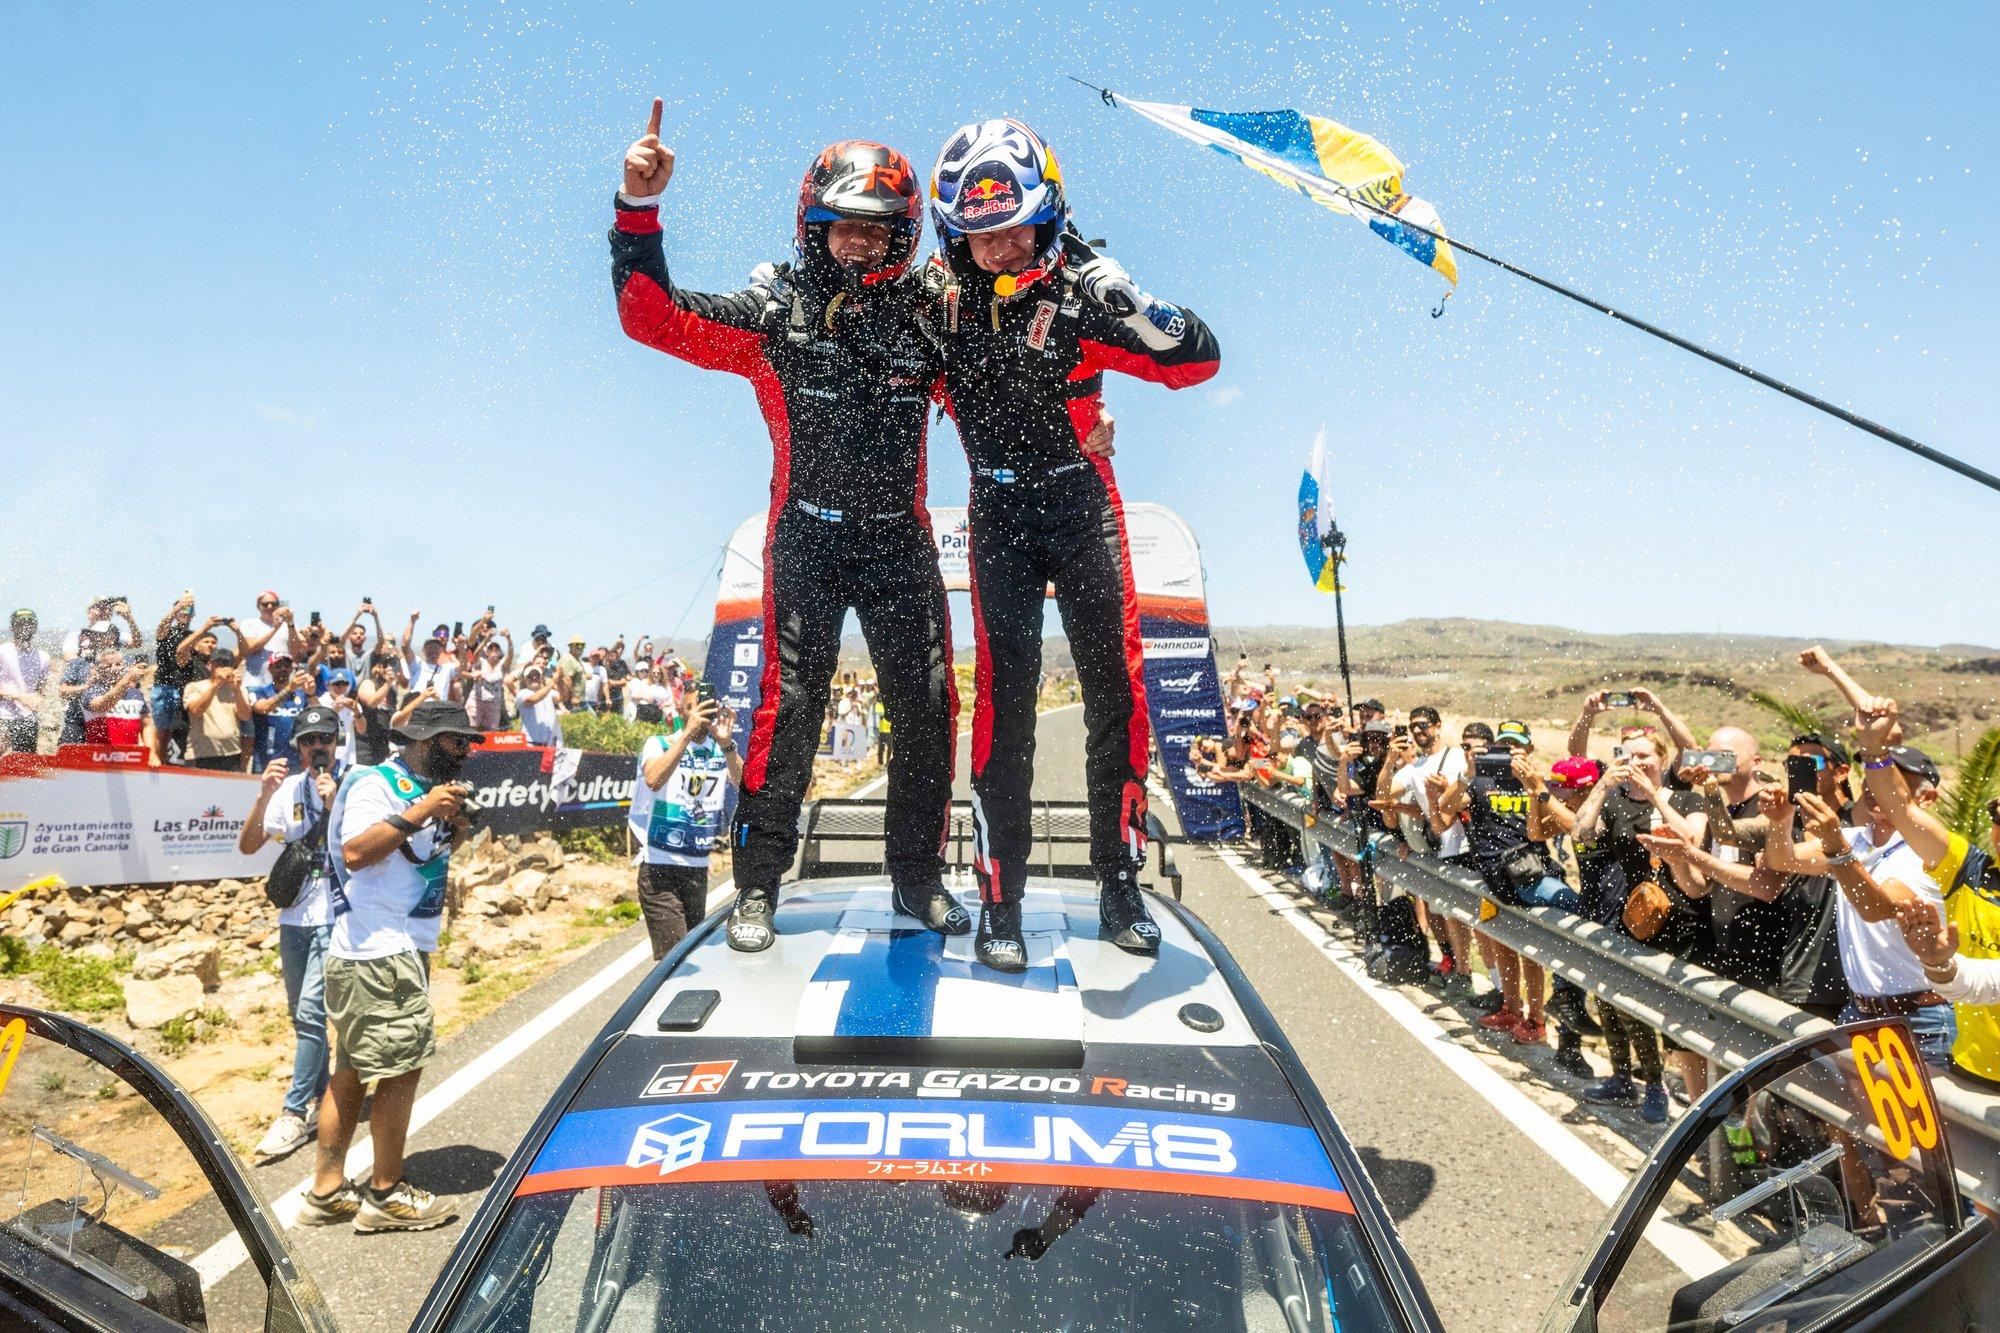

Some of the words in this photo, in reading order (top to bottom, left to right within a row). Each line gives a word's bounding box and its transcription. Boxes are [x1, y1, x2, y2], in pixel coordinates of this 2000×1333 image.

[822, 164, 902, 201] GR
[964, 200, 991, 219] Red
[991, 197, 1017, 213] Bull
[1031, 306, 1053, 344] SIMPSON
[1164, 315, 1186, 336] 69
[798, 386, 838, 400] PIKI-TEAM
[942, 534, 967, 548] Pal
[92, 751, 142, 763] WRC
[36, 822, 133, 833] Ayuntamiento
[154, 820, 182, 832] Las
[188, 819, 245, 831] Palmas
[34, 833, 50, 843] de
[58, 832, 79, 842] Las
[86, 831, 131, 841] Palmas
[177, 833, 200, 841] Gran
[33, 844, 48, 854] de
[50, 843, 82, 853] Gran
[84, 842, 129, 852] Canaria
[647, 1073, 724, 1095] GR
[741, 1071, 910, 1089] TOYOTA
[918, 1070, 1081, 1097] GAZOO
[1091, 1076, 1236, 1112] Racing
[1851, 1026, 1938, 1161] 69
[722, 1112, 1237, 1173] FORUM8
[867, 1160, 993, 1176] フォーラムエイト
